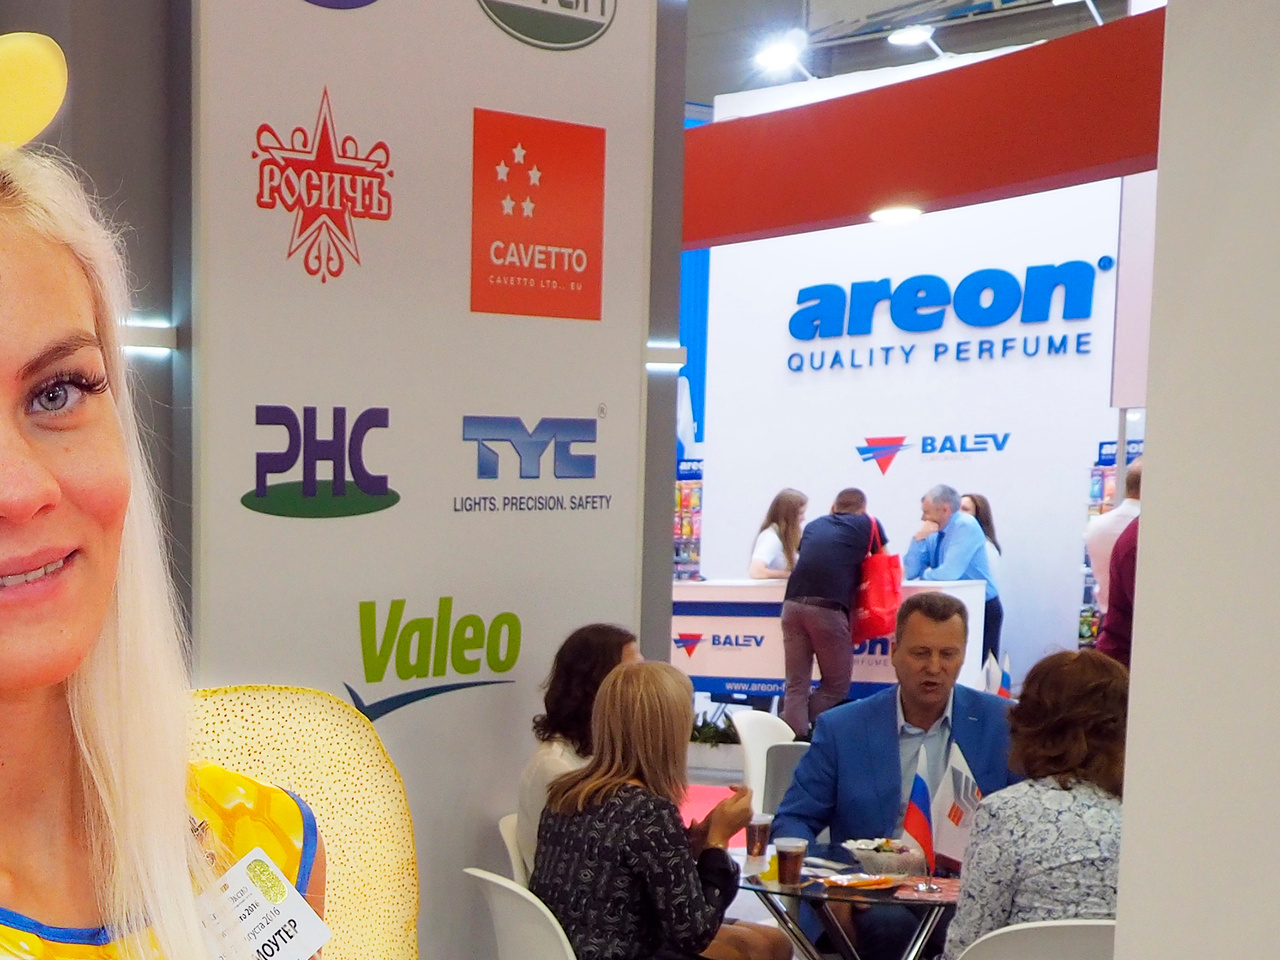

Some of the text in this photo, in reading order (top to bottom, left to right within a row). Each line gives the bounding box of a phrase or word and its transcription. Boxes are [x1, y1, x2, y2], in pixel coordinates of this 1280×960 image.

[262, 164, 389, 214] РОСИЧЪ
[489, 240, 588, 273] CAVETTO
[489, 275, 535, 287] CAVETTO
[788, 259, 1096, 341] areon
[787, 333, 1092, 372] QUALITY PERFUME
[255, 404, 389, 498] PHC
[462, 415, 597, 479] TYC
[921, 433, 1011, 453] BALEV
[453, 495, 612, 512] LIGHTS. PRECISION. SAFETY
[359, 596, 522, 684] Valeo
[712, 634, 765, 647] BALEV
[262, 907, 281, 925] 2016
